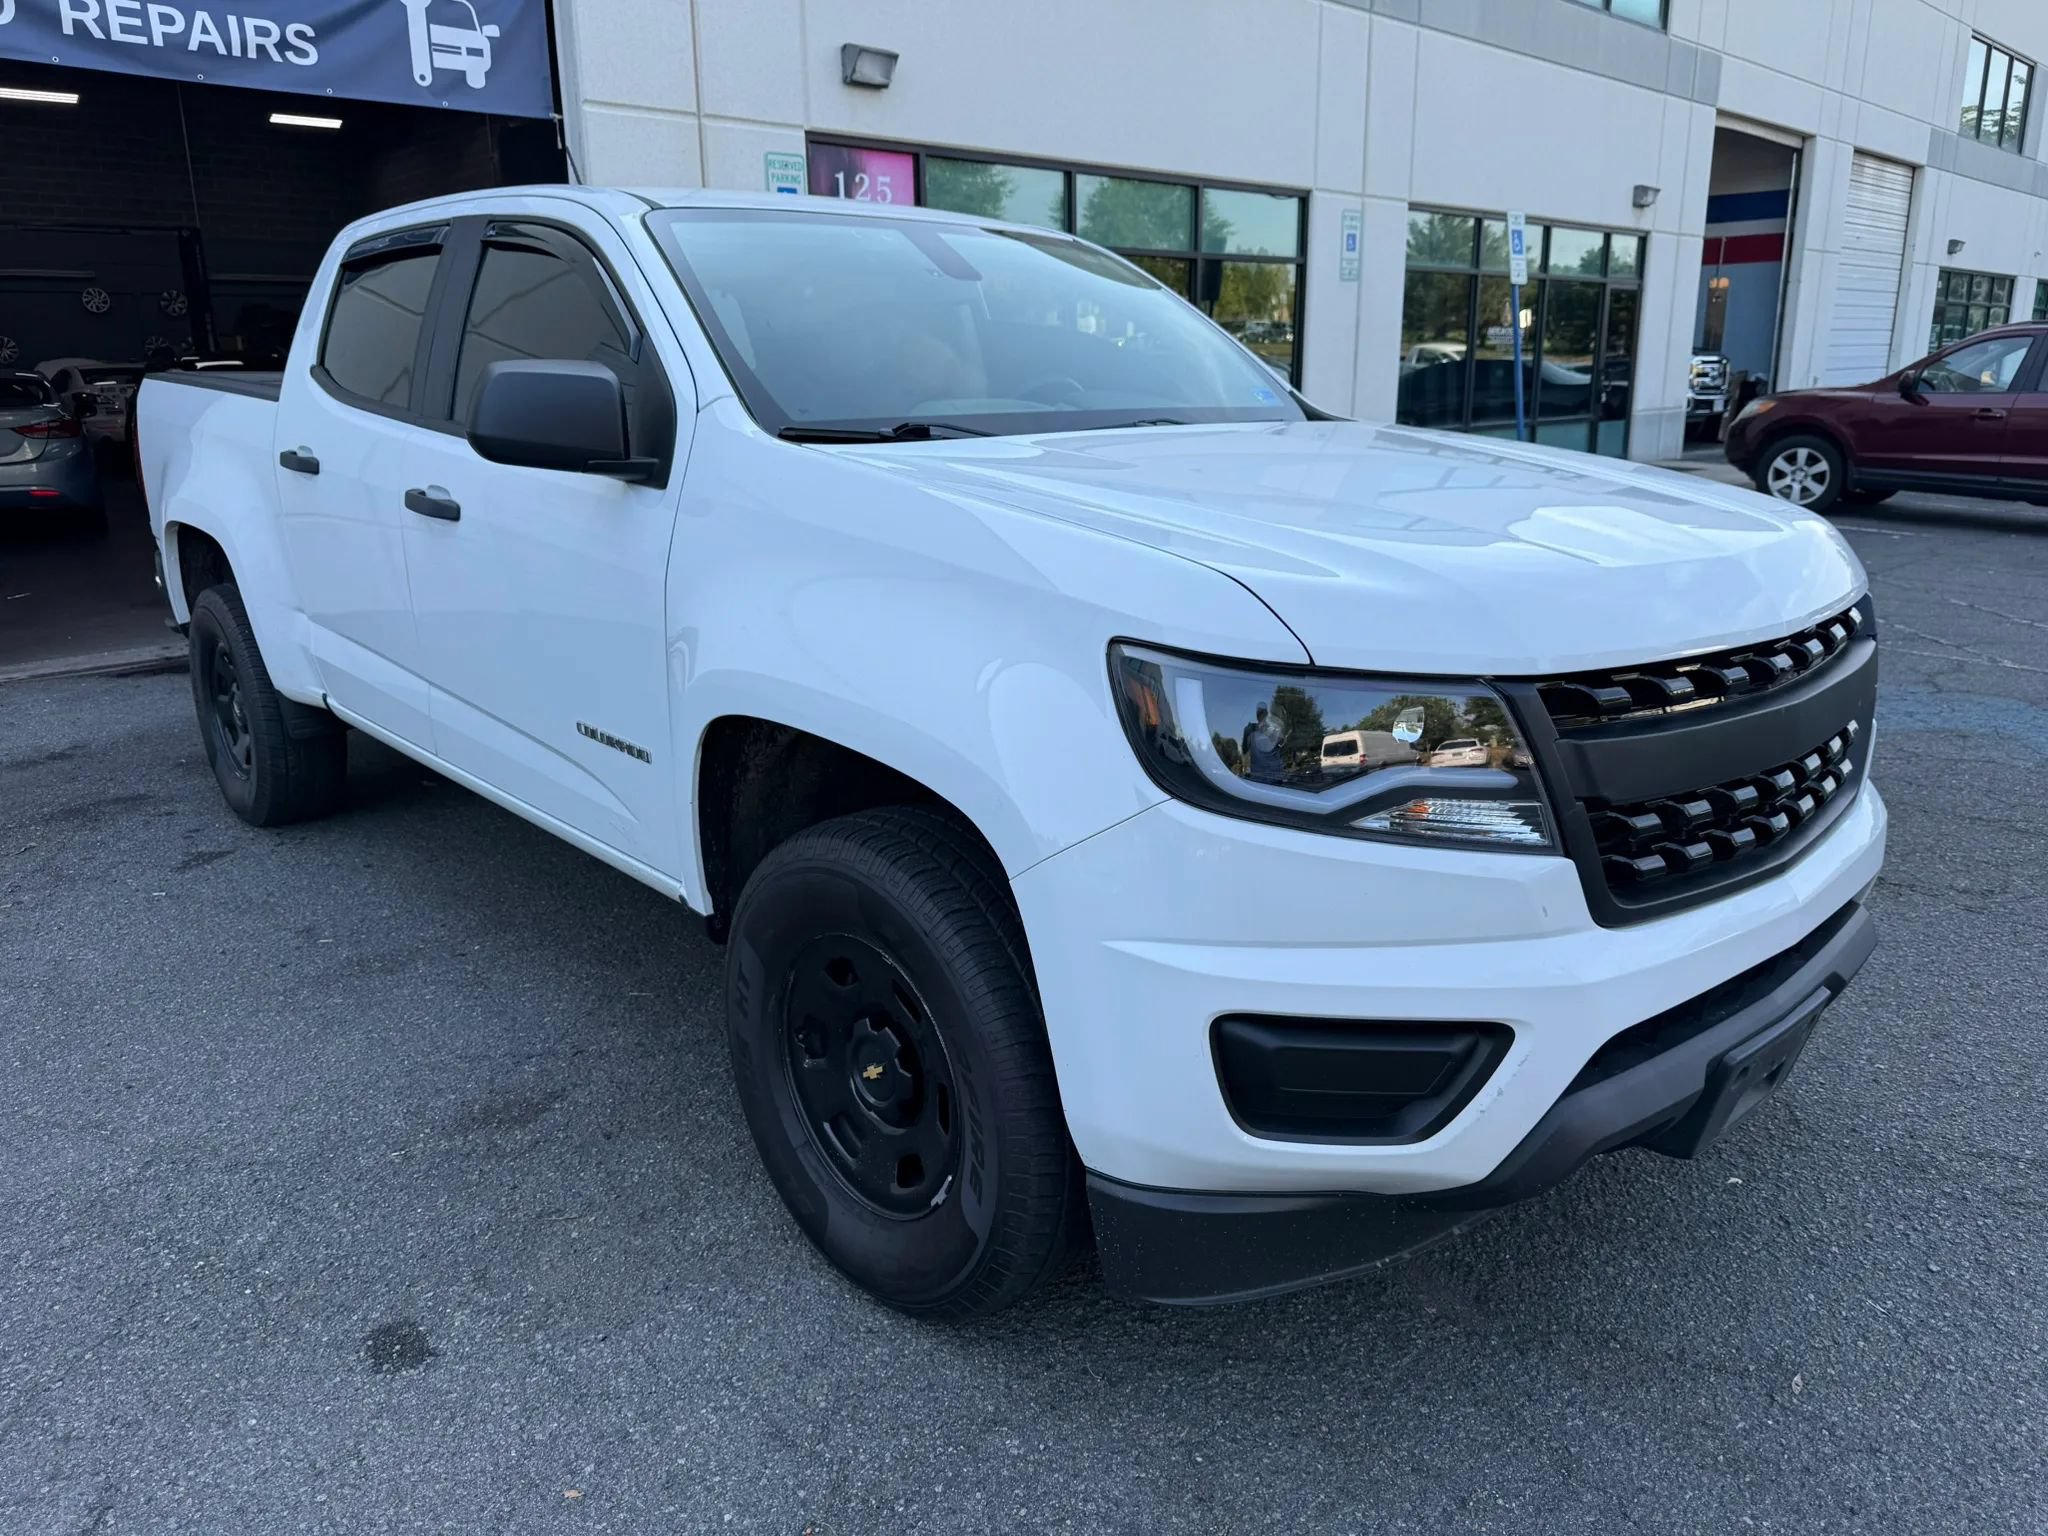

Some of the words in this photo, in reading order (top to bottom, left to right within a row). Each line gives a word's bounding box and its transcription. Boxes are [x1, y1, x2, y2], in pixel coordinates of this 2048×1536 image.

[57, 0, 319, 66] REPAIRS
[768, 159, 803, 172] RESERVED
[770, 172, 801, 184] PARKING
[834, 171, 893, 204] 125
